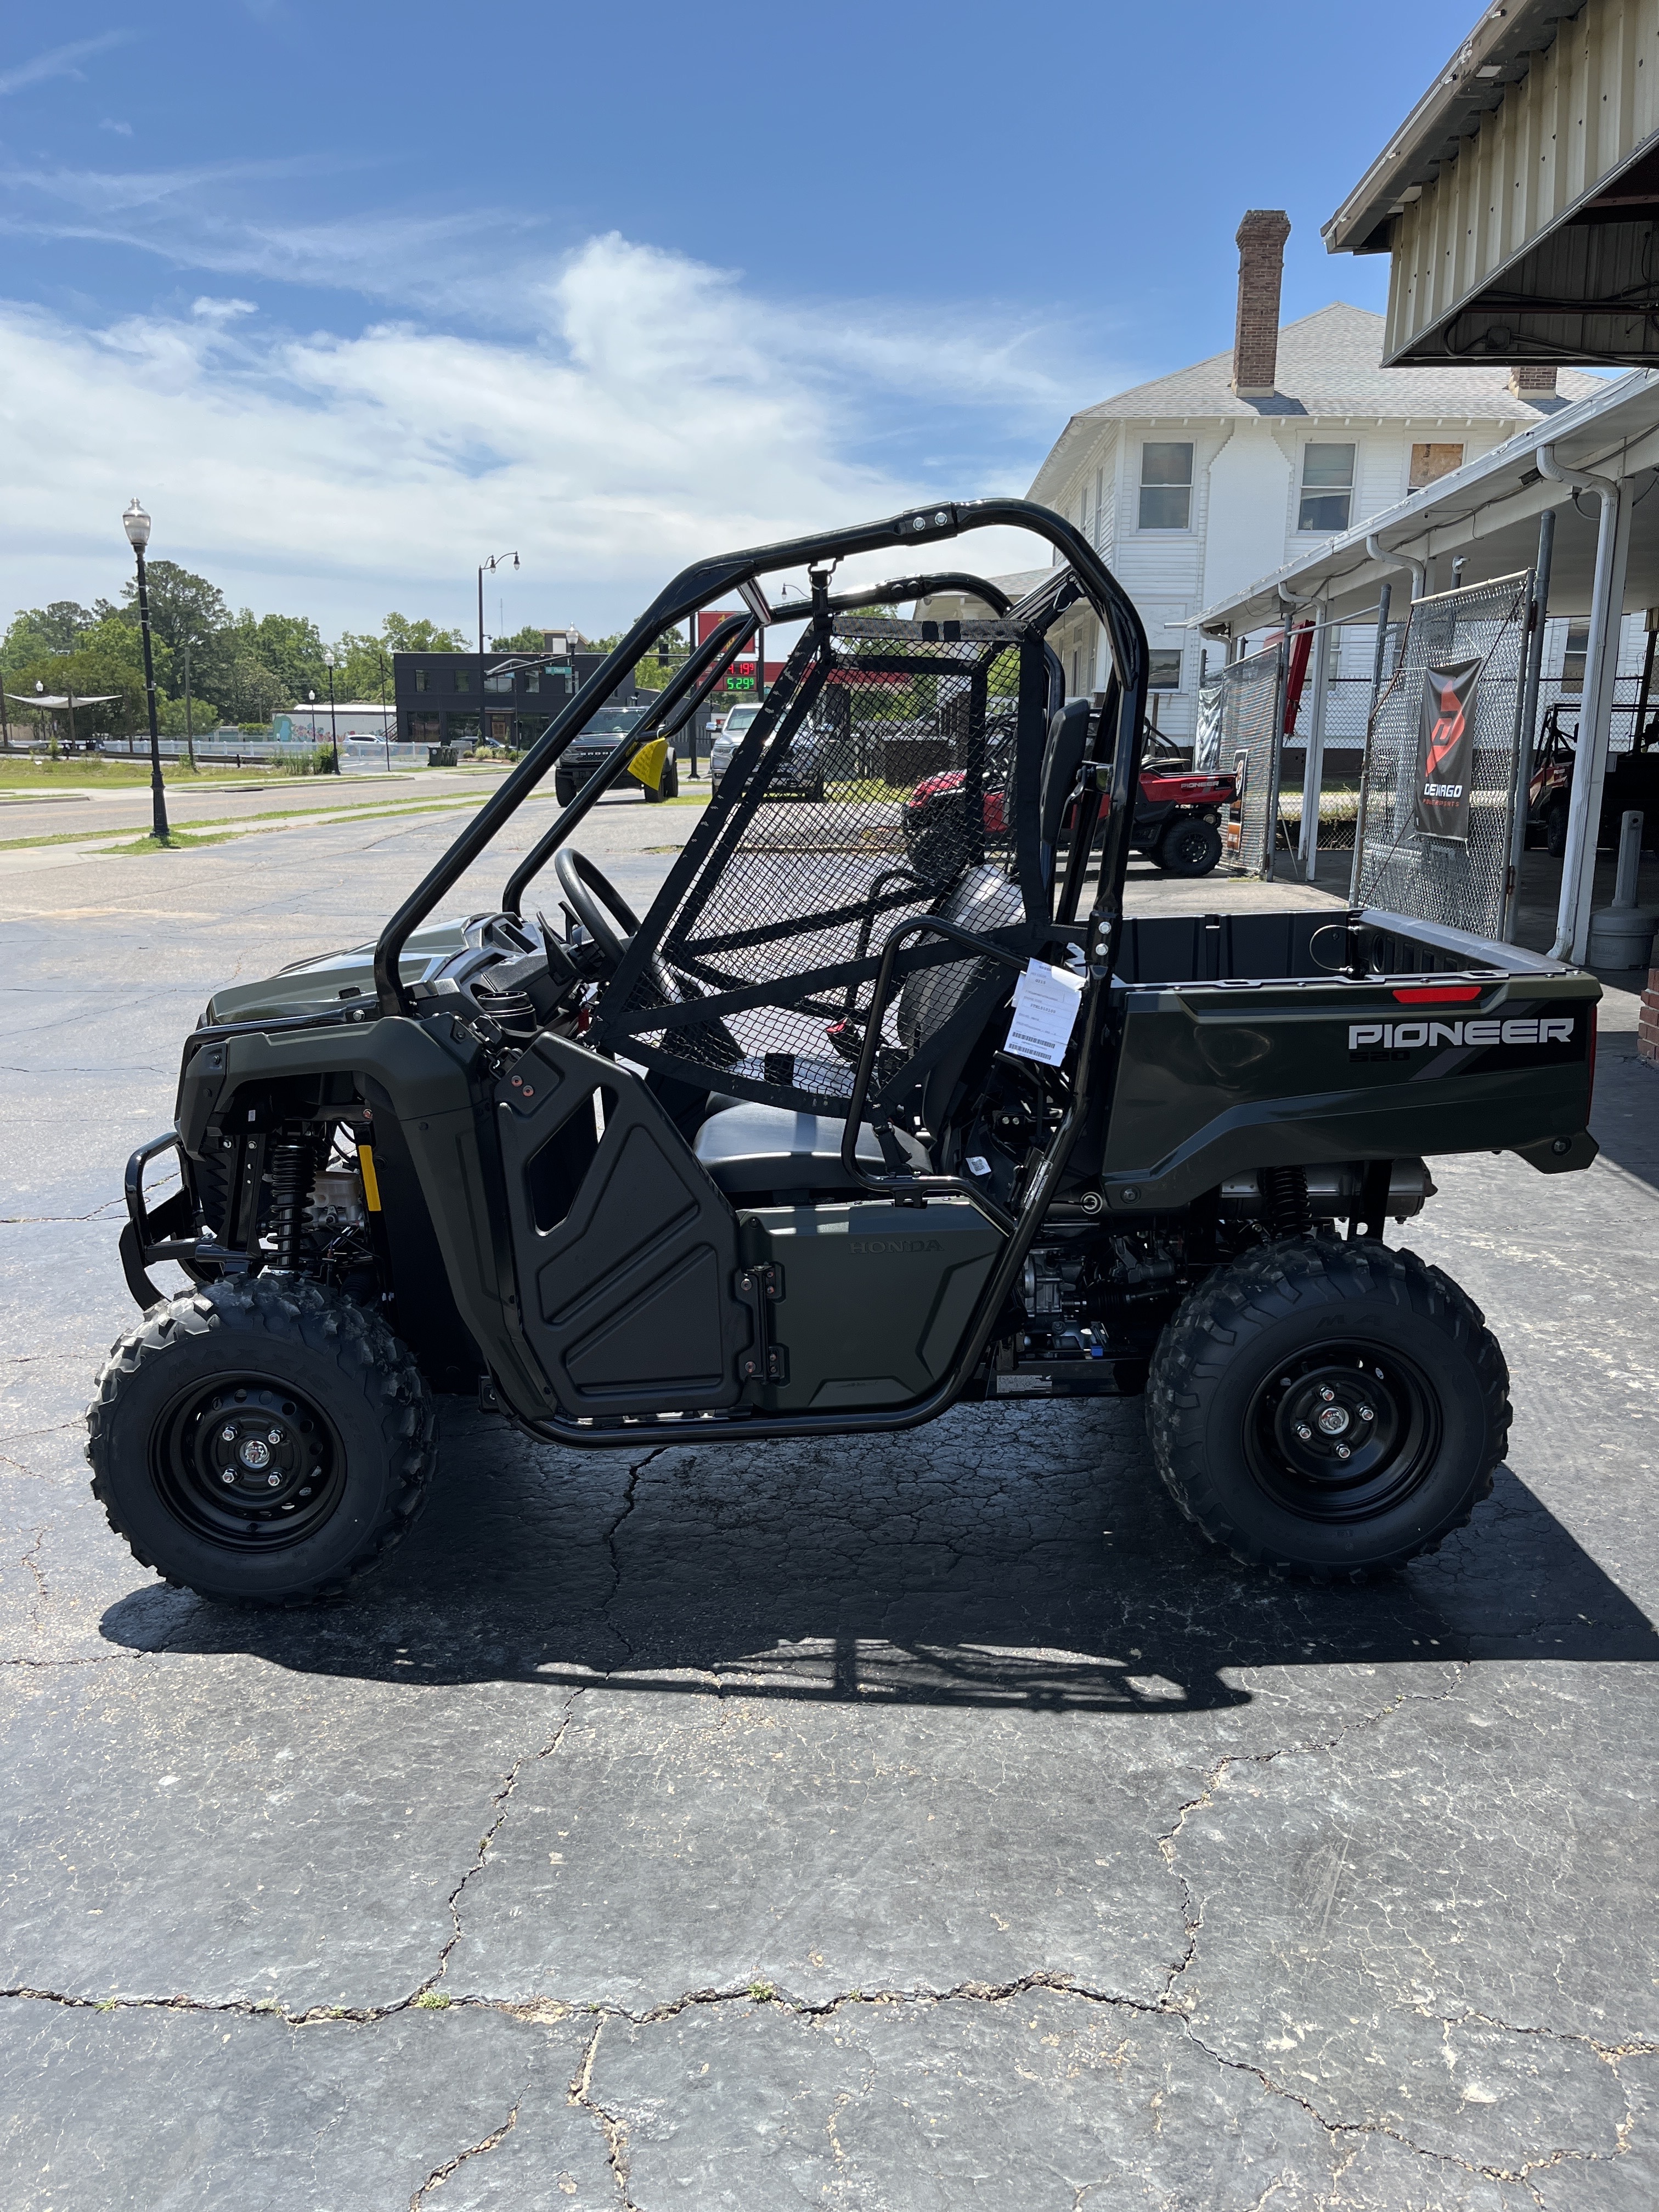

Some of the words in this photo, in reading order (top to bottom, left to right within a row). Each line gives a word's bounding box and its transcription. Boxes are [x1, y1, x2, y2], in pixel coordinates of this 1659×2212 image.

[1424, 783, 1463, 798] DENAGO
[1348, 1018, 1574, 1049] PIONEER
[848, 1239, 945, 1255] HONDA
